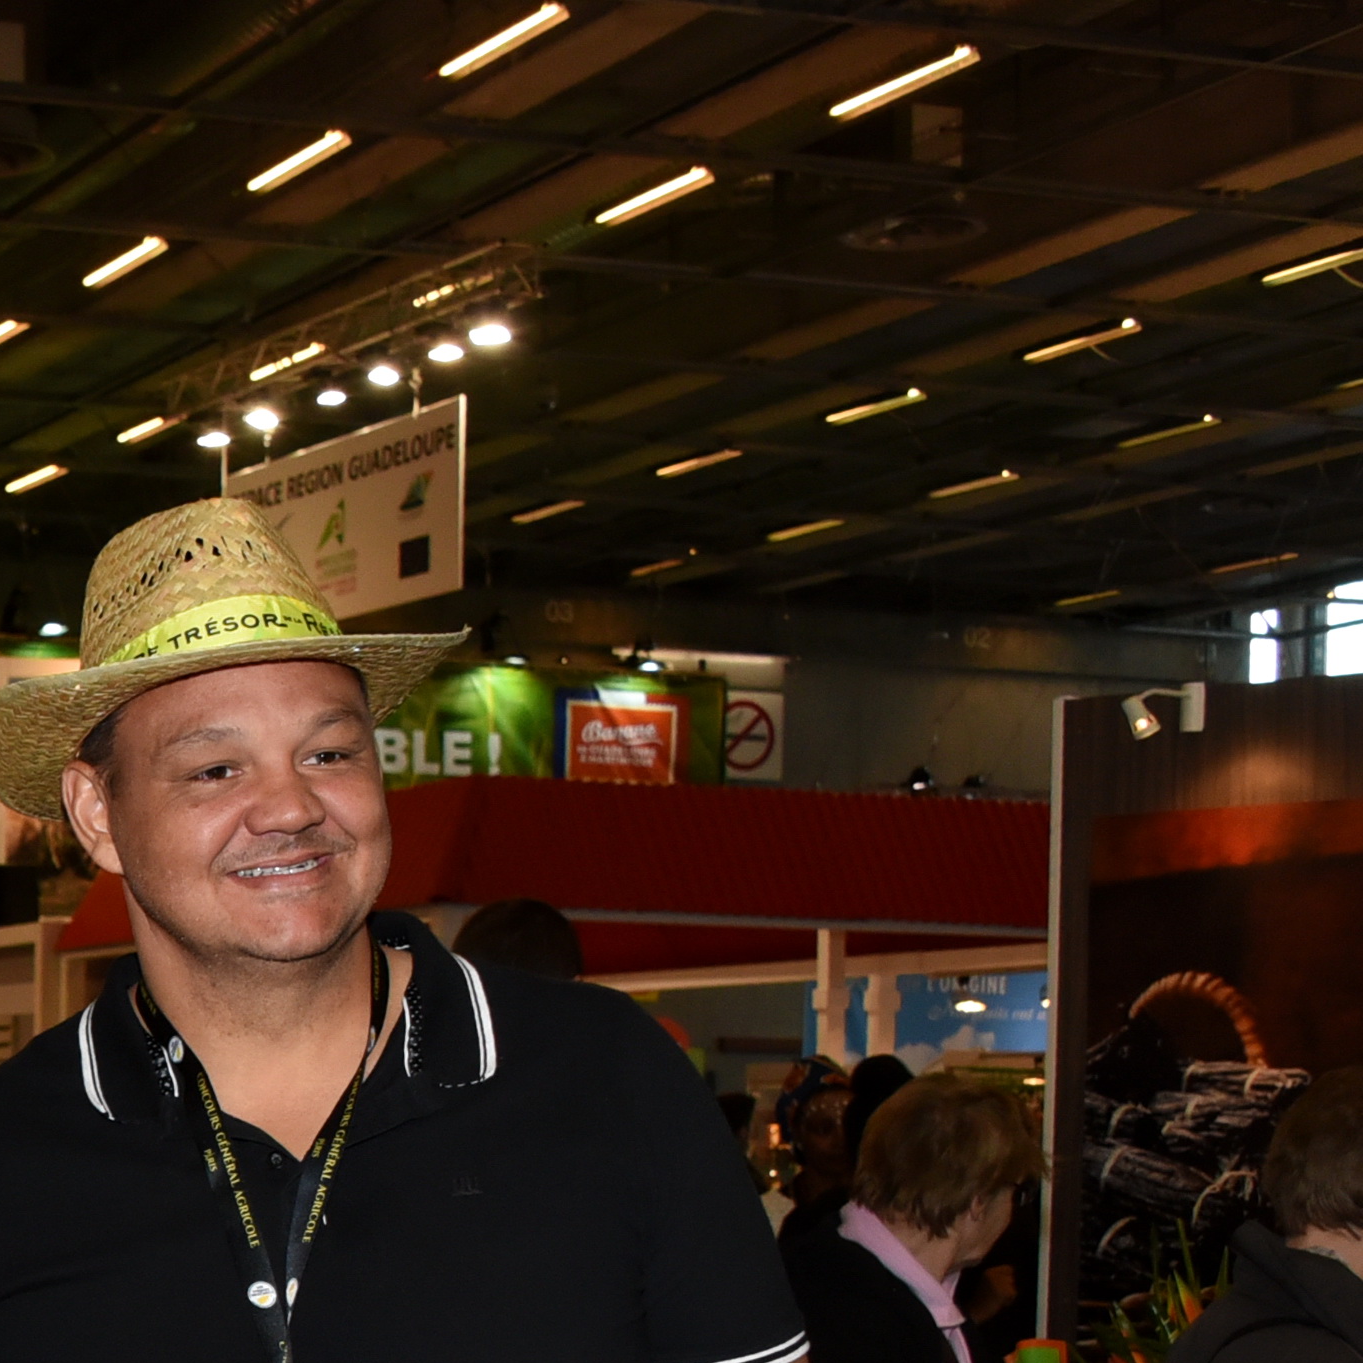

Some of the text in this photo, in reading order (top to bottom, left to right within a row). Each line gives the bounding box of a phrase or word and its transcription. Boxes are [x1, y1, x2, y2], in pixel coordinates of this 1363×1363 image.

[286, 461, 344, 499] REGION
[347, 424, 456, 482] GUADELOUPE
[167, 613, 287, 649] TRÉSOR
[203, 1148, 219, 1173] PARIS
[321, 1128, 346, 1182] GÉNÉRAL
[215, 1131, 240, 1188] GÉNÉRAL
[233, 1189, 261, 1249] AGRICOLE
[302, 1184, 327, 1244] AGRICOLE
